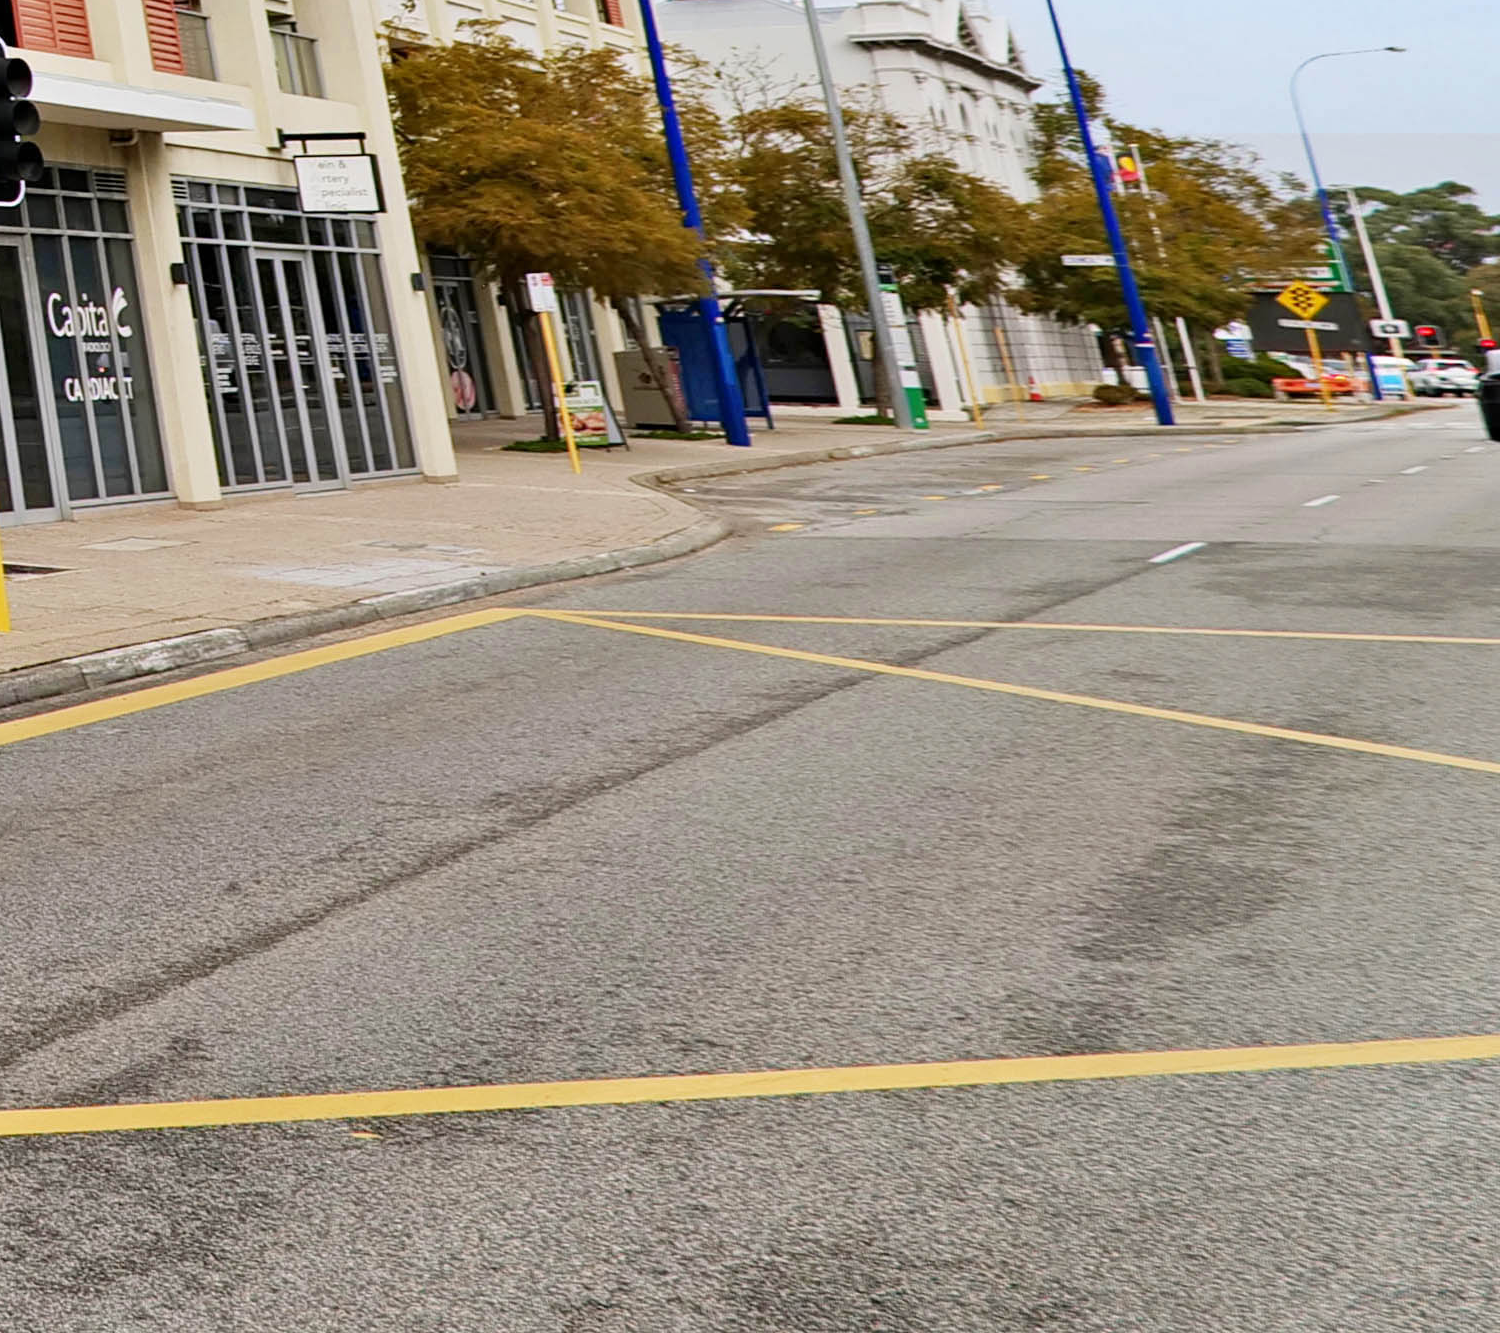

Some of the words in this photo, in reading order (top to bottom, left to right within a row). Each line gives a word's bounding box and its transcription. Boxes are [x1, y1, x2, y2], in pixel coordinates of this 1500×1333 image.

[312, 187, 369, 198] pecialist
[48, 293, 111, 337] Caita
[64, 377, 120, 402] CADIAC
